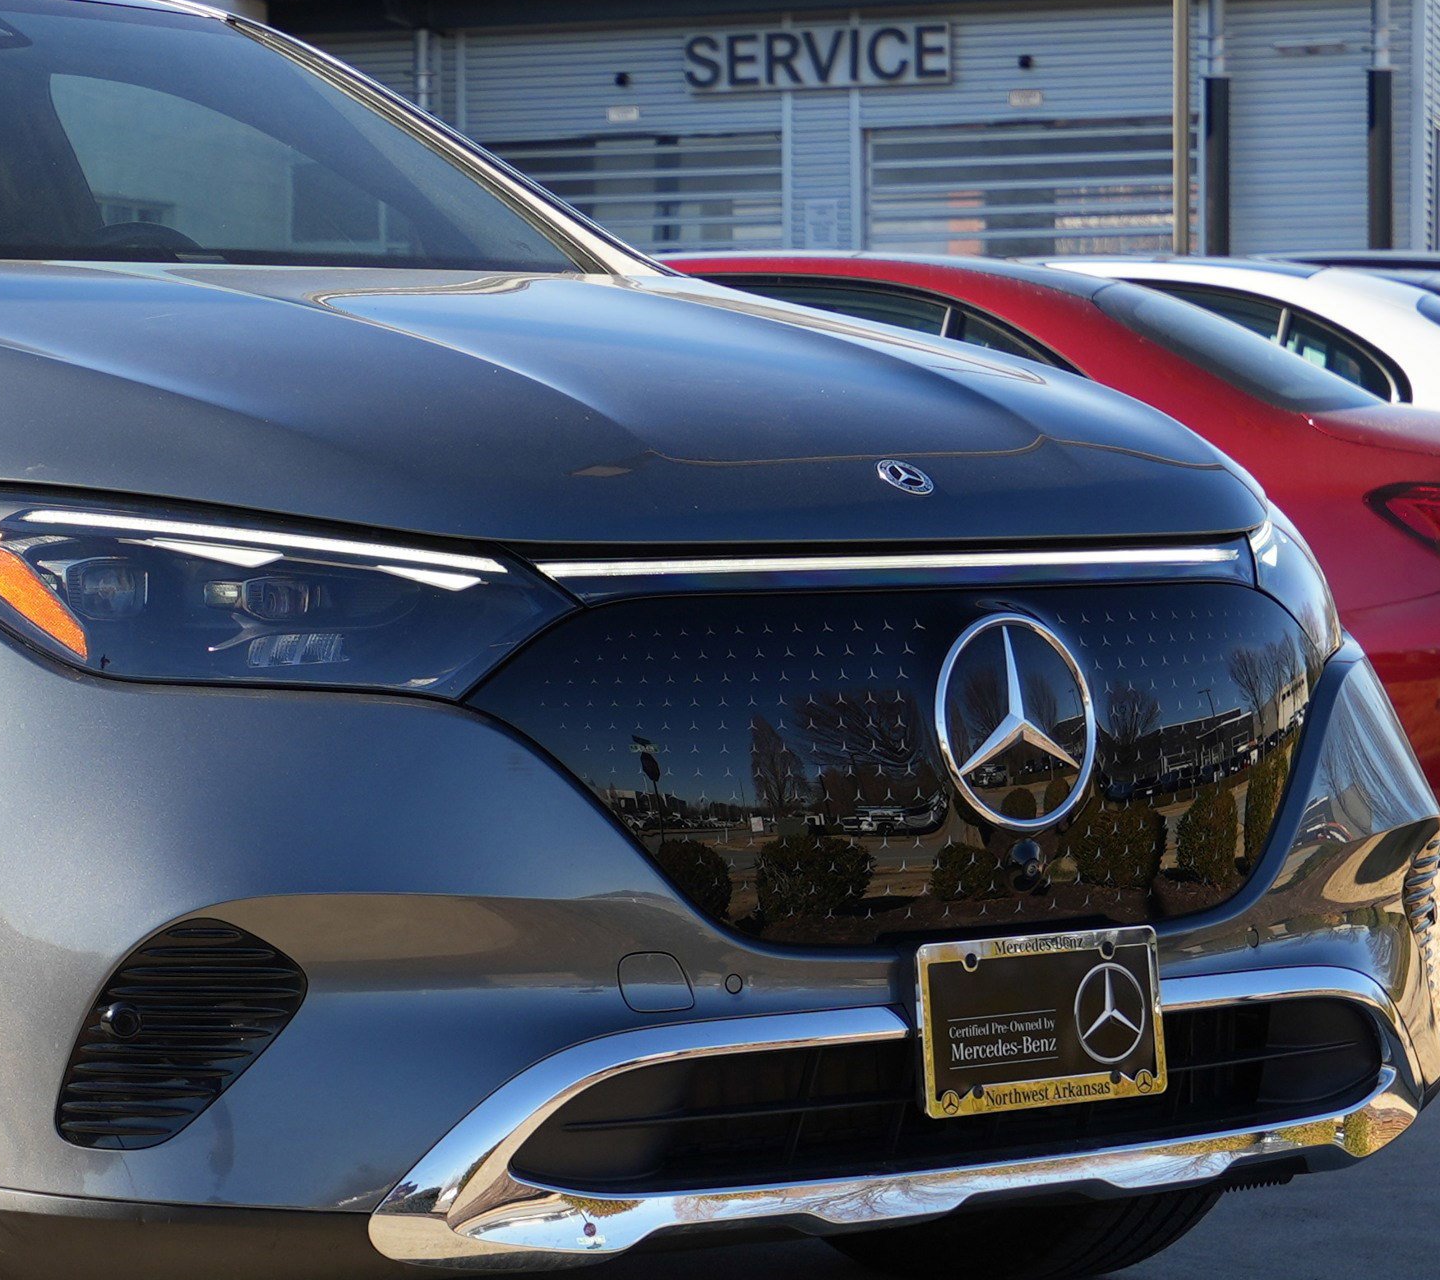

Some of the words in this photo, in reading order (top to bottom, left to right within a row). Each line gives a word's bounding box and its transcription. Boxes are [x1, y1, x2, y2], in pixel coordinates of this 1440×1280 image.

[684, 24, 949, 88] SERVICE
[994, 936, 1084, 956] Mercedes-Benz
[948, 1023, 989, 1039] Certified
[991, 1018, 1042, 1035] Pre-Owned
[1044, 1017, 1055, 1031] by
[951, 1035, 1057, 1062] Mercedes-Benz
[985, 1085, 1050, 1107] Northwest
[1052, 1079, 1111, 1099] Arkansas
